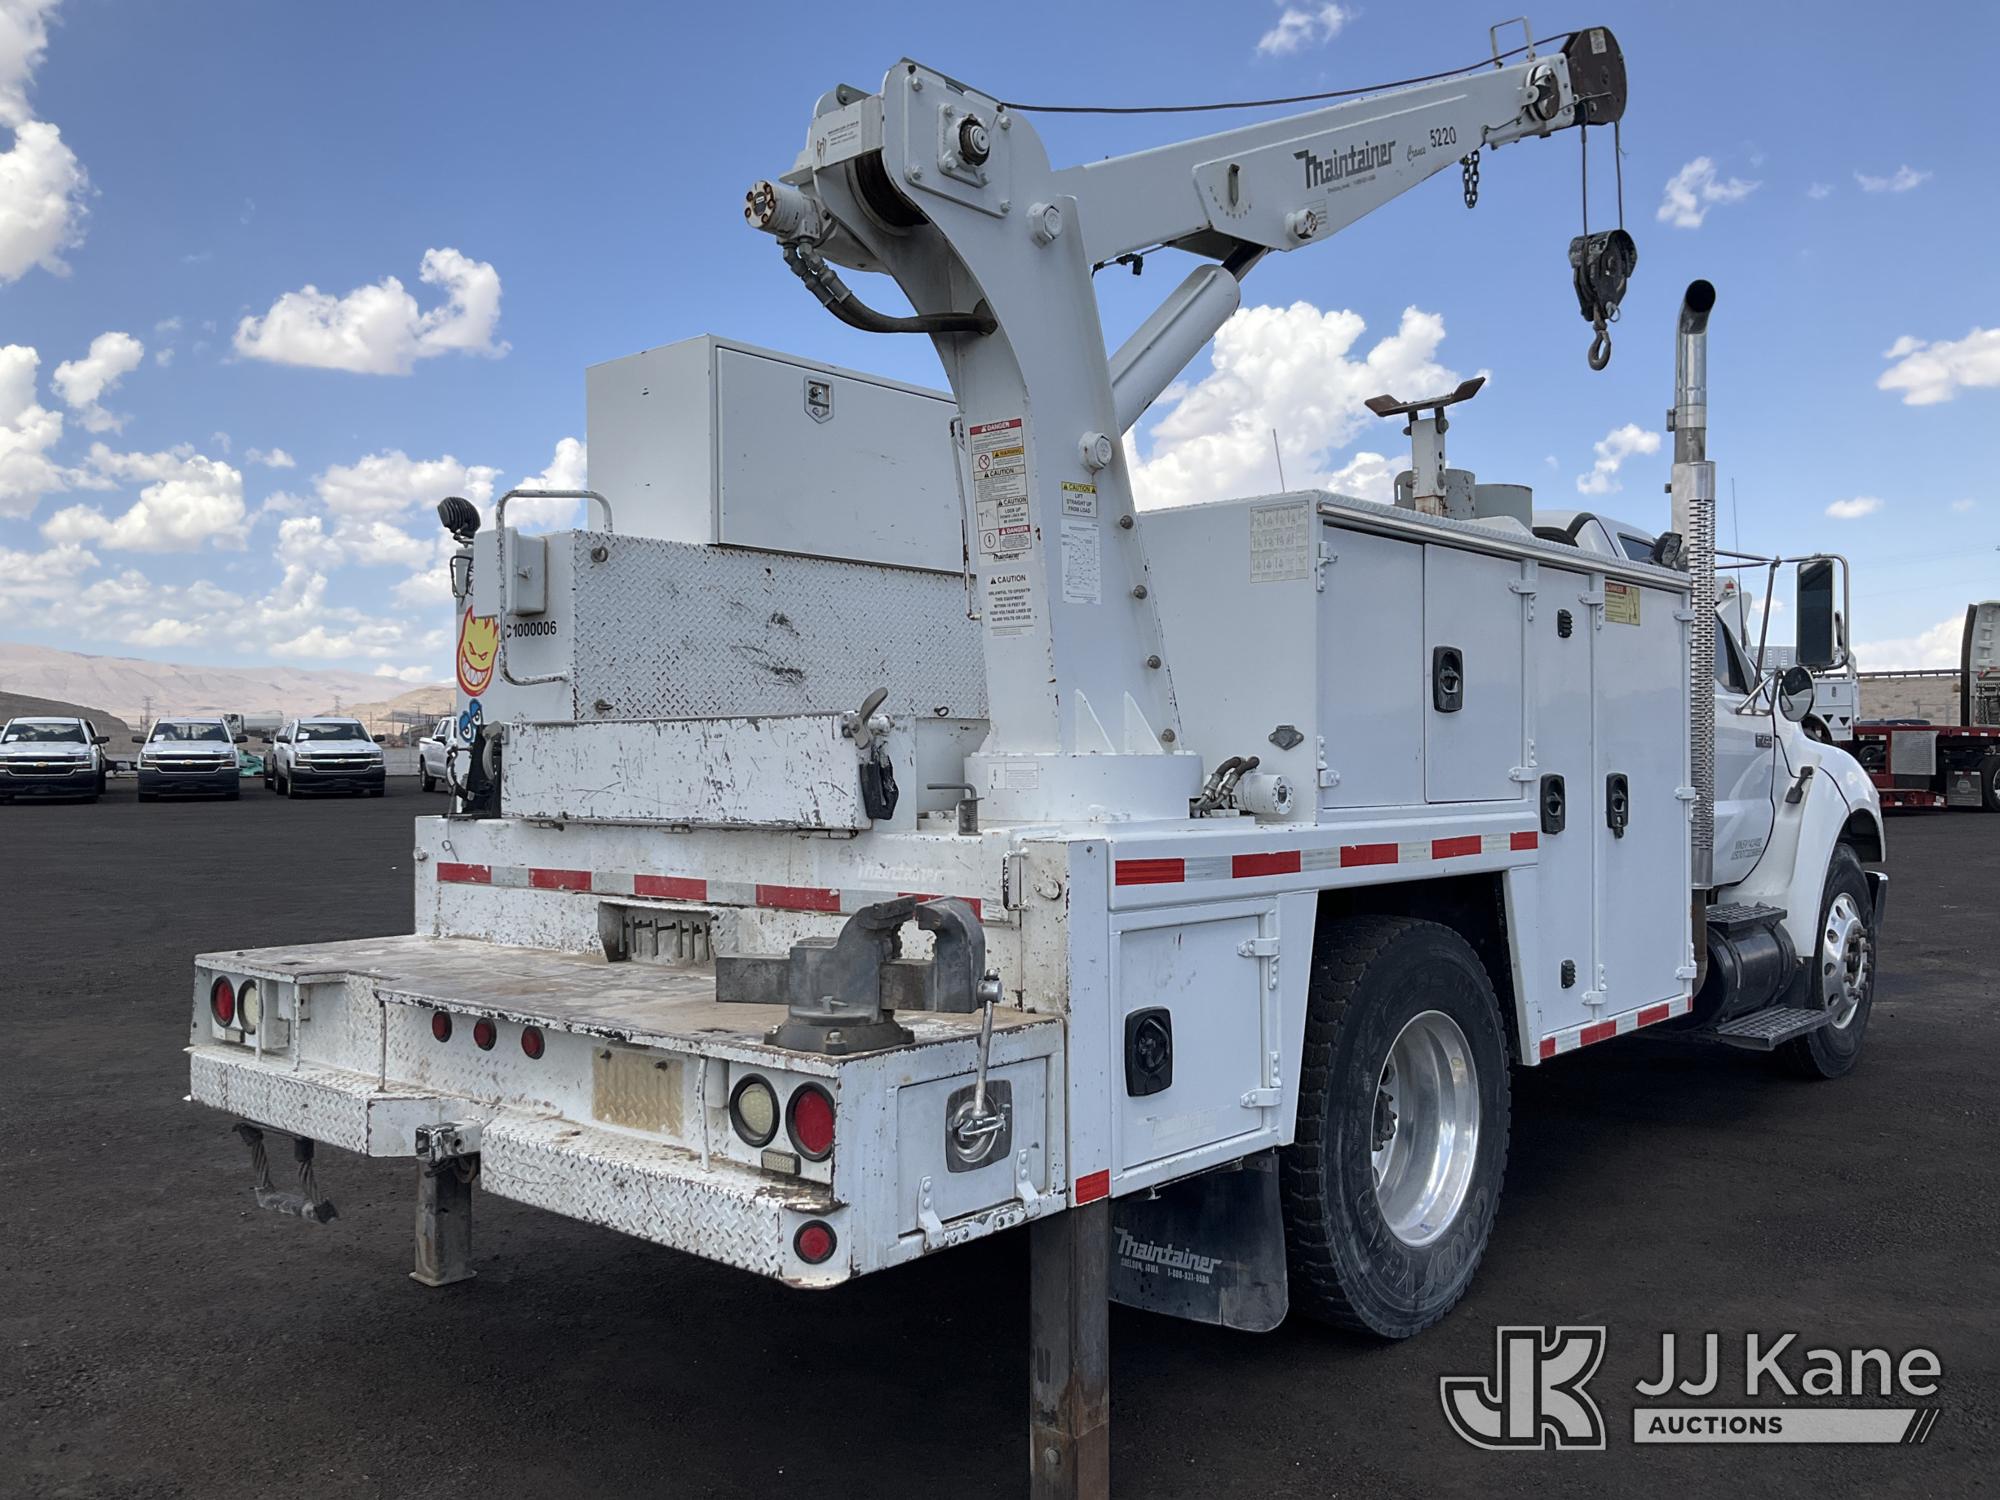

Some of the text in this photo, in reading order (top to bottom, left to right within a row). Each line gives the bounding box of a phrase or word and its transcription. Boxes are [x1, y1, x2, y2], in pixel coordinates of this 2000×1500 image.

[1429, 126, 1457, 148] 5220
[1293, 140, 1396, 189] Maintainer
[986, 421, 1010, 431] DANGER
[990, 468, 1015, 477] CAUTION
[1068, 483, 1091, 493] CAUTION
[1003, 497, 1027, 505] CAUTION
[1007, 525, 1029, 534] DANGER
[997, 574, 1026, 583] CAUTION
[1113, 1226, 1223, 1274] Maintainer
